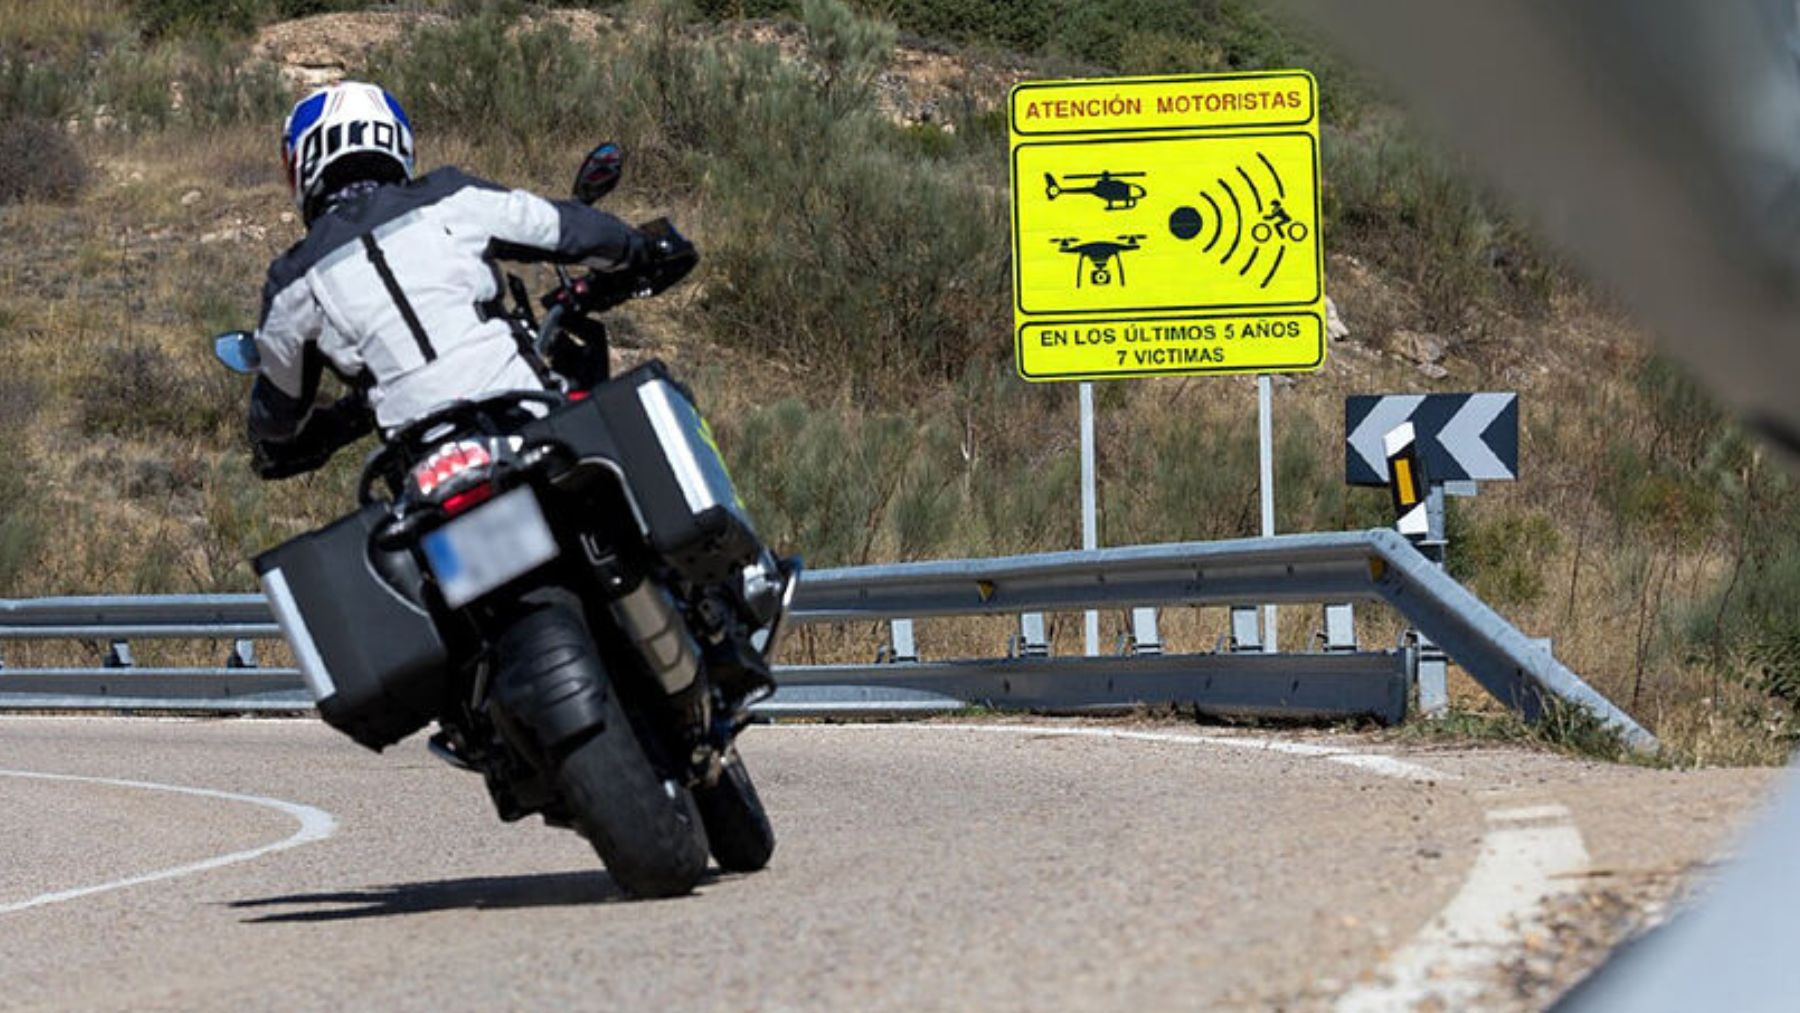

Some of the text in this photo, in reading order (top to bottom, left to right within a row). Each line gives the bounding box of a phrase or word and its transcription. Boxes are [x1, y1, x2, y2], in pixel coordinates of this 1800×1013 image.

[1025, 91, 1301, 120] ATENCIÓN MOTORISTAS
[1040, 319, 1300, 346] EN LOS ÚLTIMOS 5 AÑOS
[1117, 348, 1225, 365] 7 VICTIMAS
